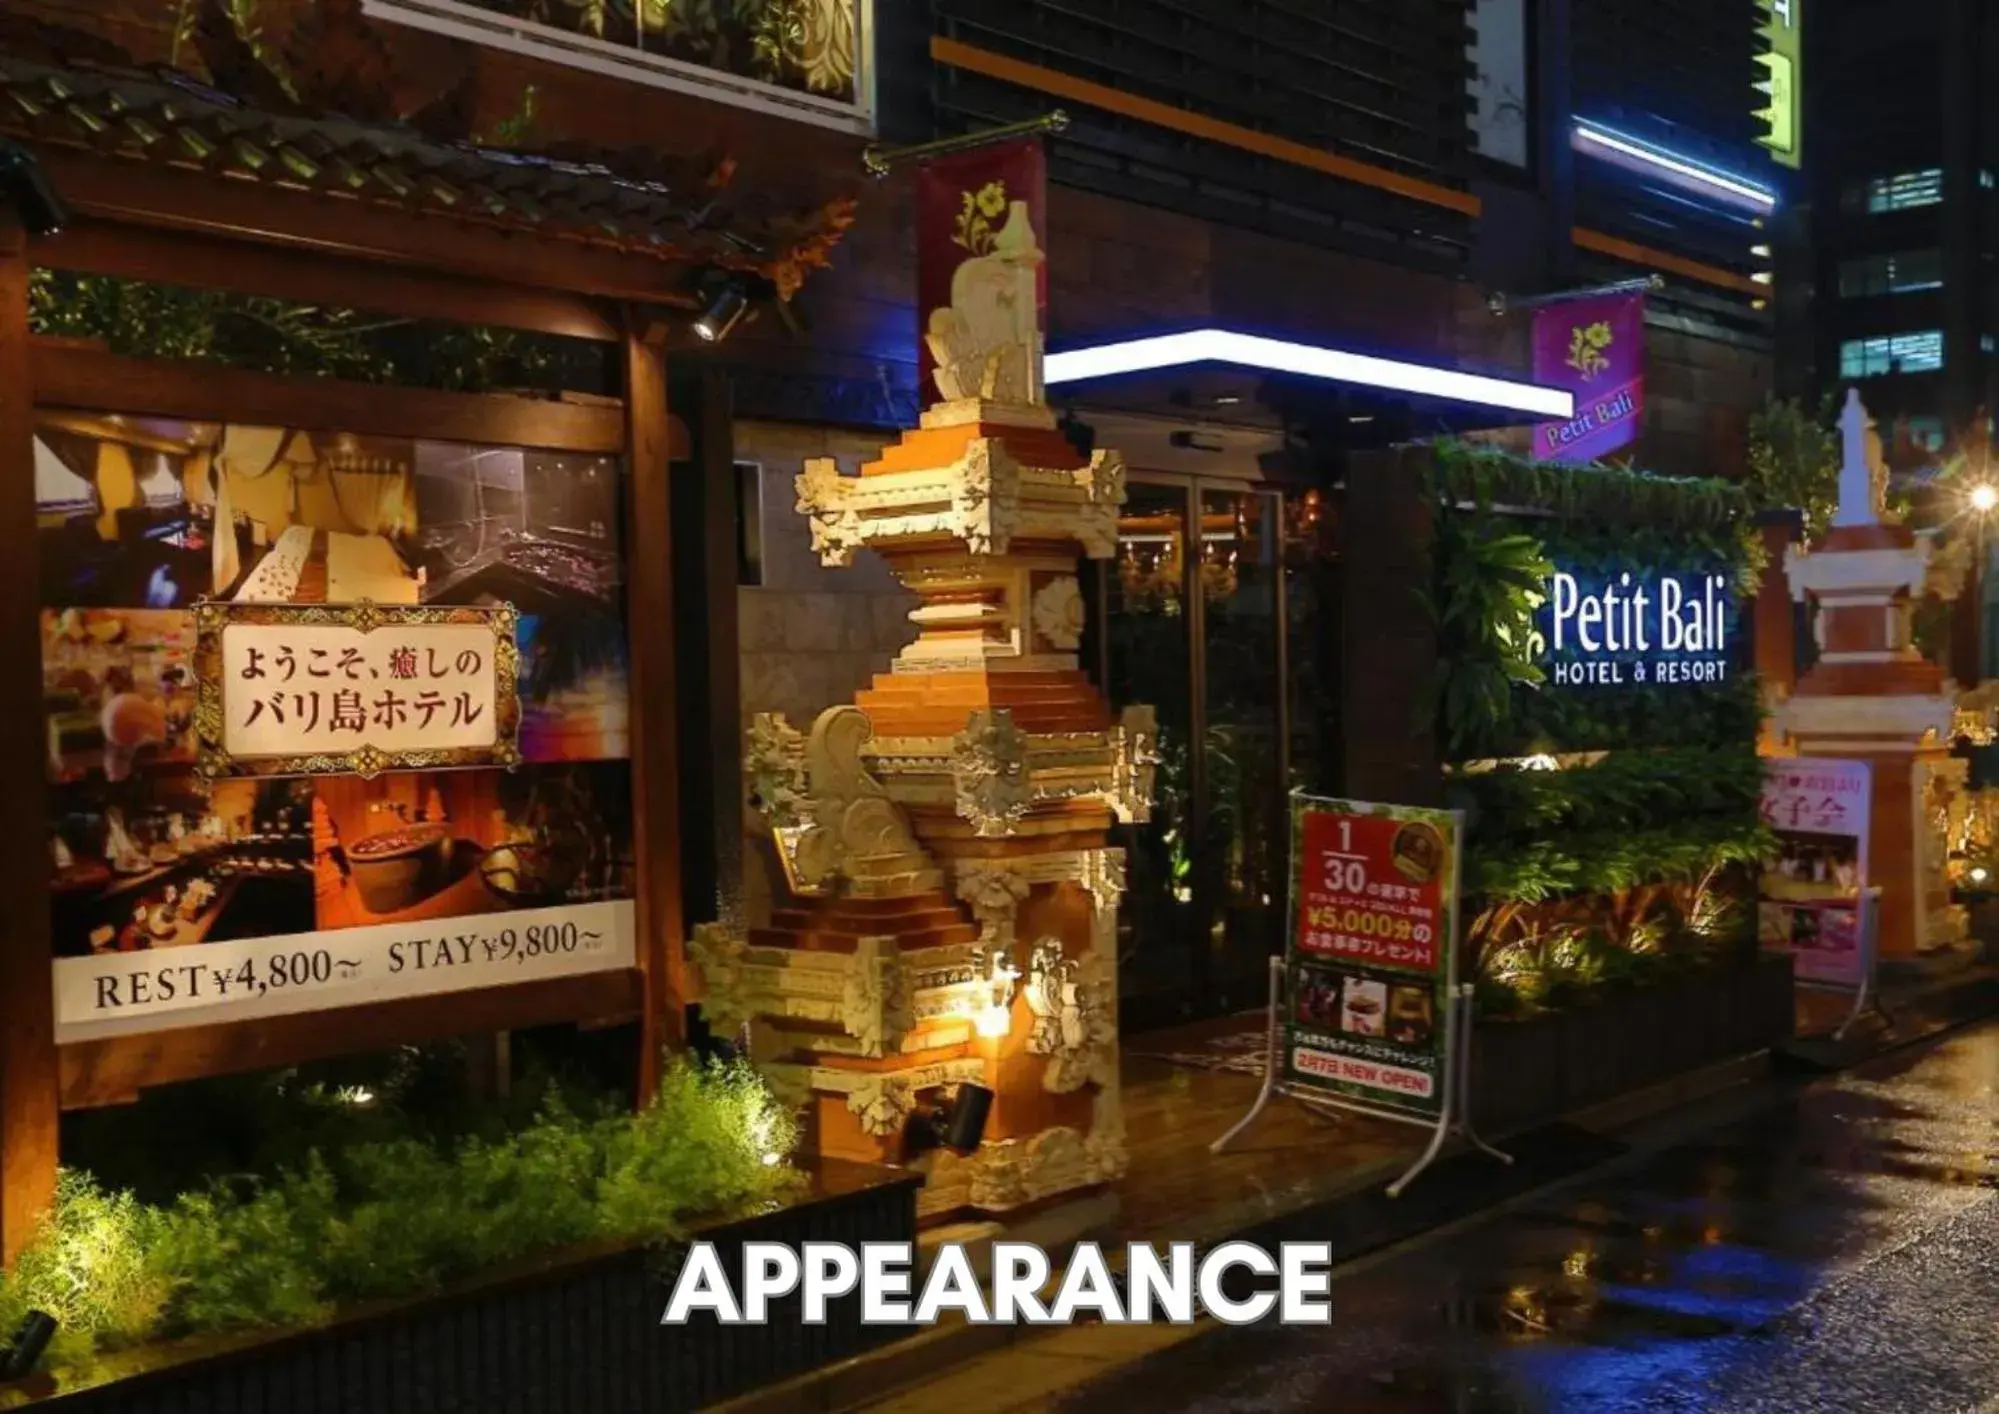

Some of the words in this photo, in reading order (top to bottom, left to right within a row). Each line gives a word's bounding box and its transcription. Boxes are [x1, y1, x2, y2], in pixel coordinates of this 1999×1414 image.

[1546, 411, 1593, 449] Petit
[1594, 390, 1633, 424] Bali
[1553, 571, 1651, 653] Petit
[1660, 574, 1726, 653] Bali
[240, 645, 482, 683] ようこそ、癒しの
[1554, 660, 1624, 685] HOTEL
[1633, 660, 1647, 683] &
[1655, 659, 1727, 683] RESORT
[243, 687, 483, 735] バリ島ホテル
[94, 963, 208, 1009] REST
[388, 933, 478, 973] STAY
[1342, 1061, 1377, 1082] NEW
